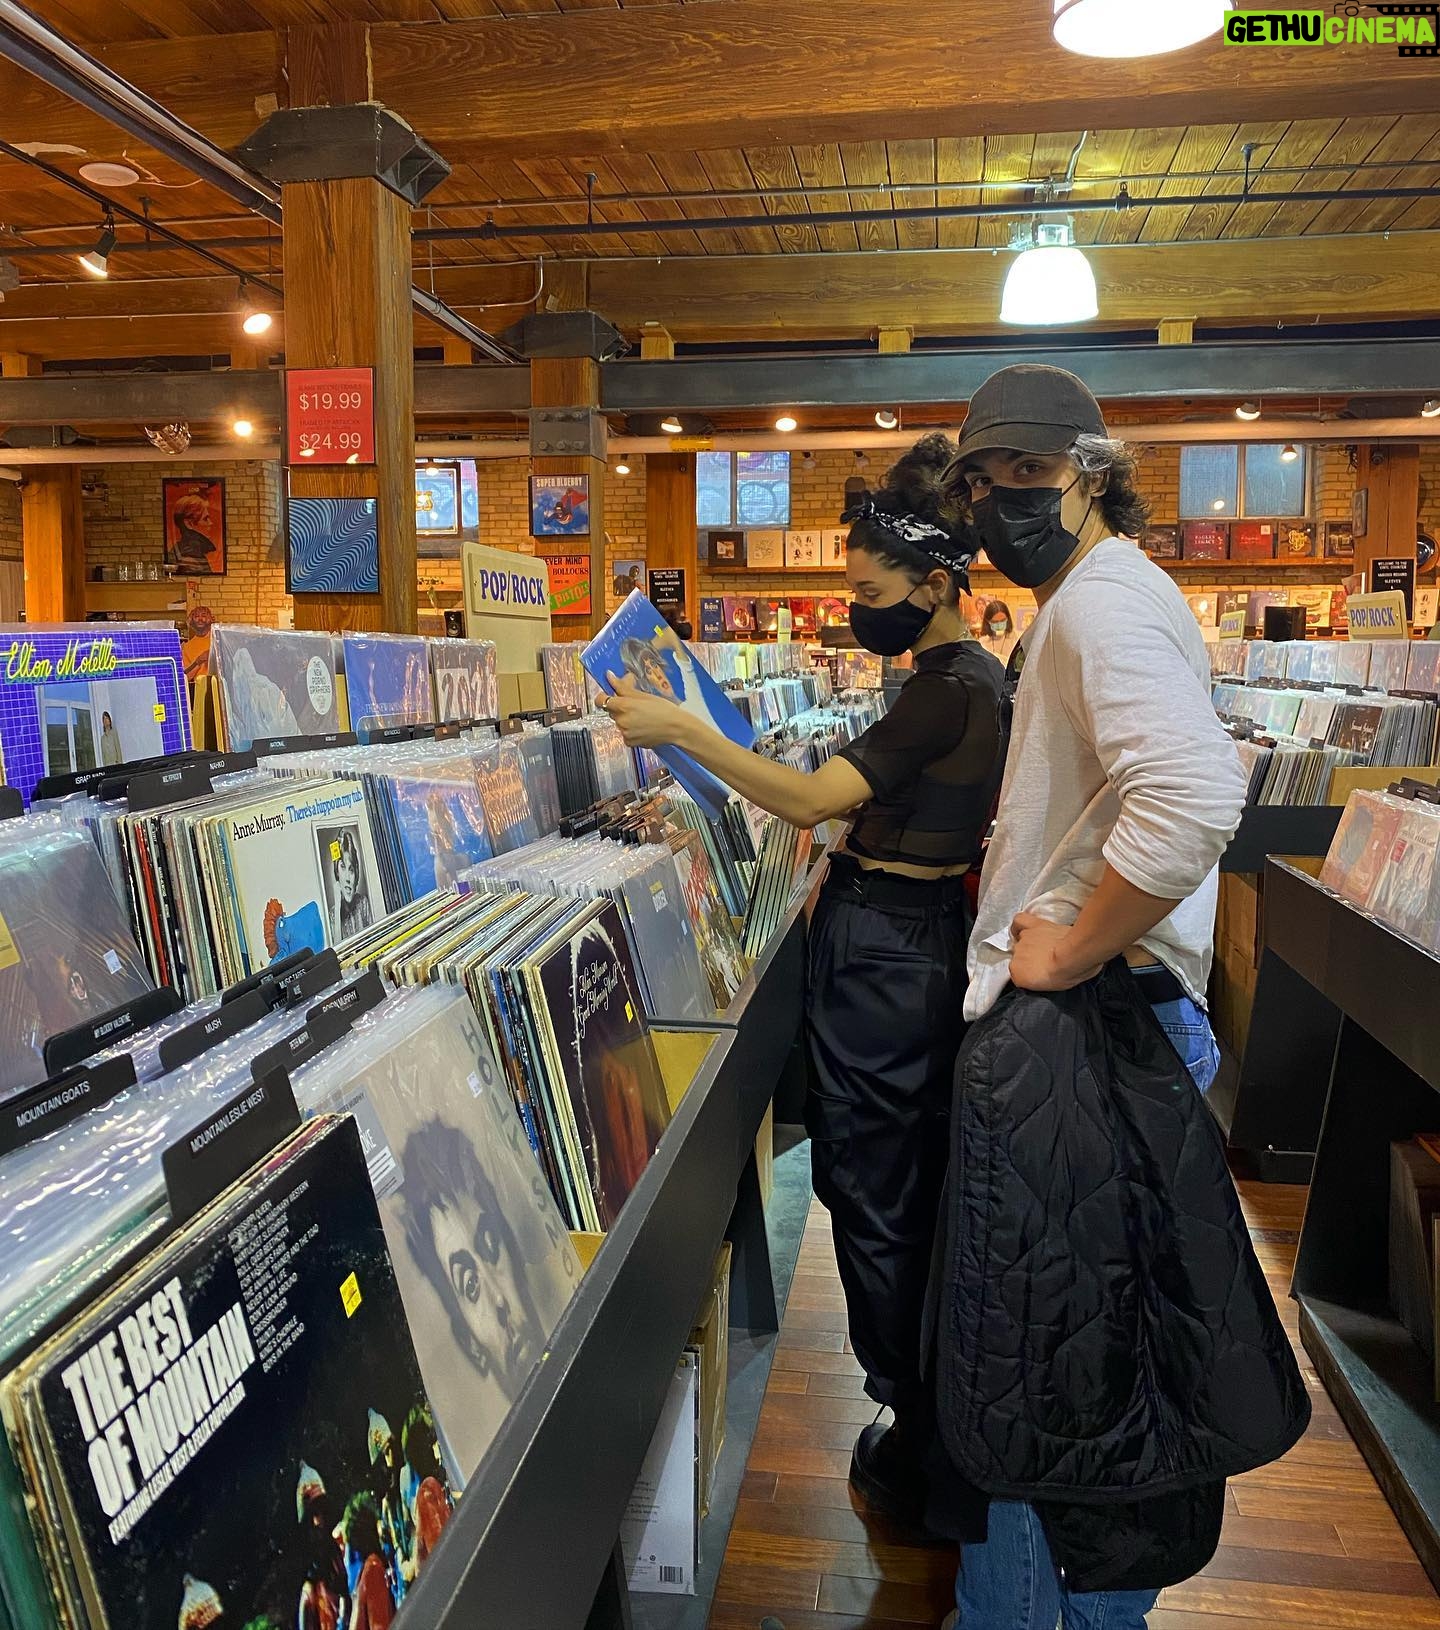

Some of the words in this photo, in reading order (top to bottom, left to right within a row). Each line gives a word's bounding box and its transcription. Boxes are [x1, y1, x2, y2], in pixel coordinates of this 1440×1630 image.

[299, 392, 361, 413] $19.99
[299, 432, 361, 450] $24.99
[542, 556, 563, 566] EVER
[565, 556, 582, 565] MIND
[552, 568, 589, 576] BOLLOCKS
[480, 569, 546, 606] POP/ROCK
[1350, 606, 1396, 630] POP/ROCK
[7, 641, 53, 680] Elton
[56, 638, 117, 676] Motello
[233, 821, 256, 841] Anne
[204, 1017, 222, 1034] MUSH
[16, 1094, 63, 1128] MOUNTAIN
[61, 1080, 91, 1104] GOATS
[246, 1087, 265, 1109] WEST
[255, 1200, 273, 1220] QUEEN
[236, 1261, 251, 1279] ROLL
[249, 1248, 264, 1267] OVER
[262, 1225, 290, 1255] BEETHOVEN
[240, 1274, 252, 1291] FOR
[272, 1241, 287, 1260] FARM
[242, 1286, 255, 1301] THE
[253, 1269, 273, 1292] ANIMAL
[271, 1250, 291, 1275] TRAINER
[289, 1242, 300, 1257] AND
[298, 1233, 309, 1247] THE
[307, 1223, 319, 1240] TOAD
[245, 1291, 263, 1314] NEVER
[262, 1285, 270, 1298] IN
[275, 1267, 287, 1285] LIFE
[248, 1303, 265, 1326] DON'T
[264, 1291, 279, 1310] LOOK
[278, 1272, 298, 1297] AROUND
[252, 1296, 288, 1337] CROSSROADER
[275, 1314, 298, 1343] CHORALE
[61, 1331, 135, 1442] THE
[118, 1276, 193, 1393] BEST
[262, 1352, 277, 1374] BOYS
[275, 1346, 283, 1359] IN
[281, 1335, 293, 1352] THE
[290, 1322, 305, 1342] BAND
[87, 1417, 137, 1518] OF
[124, 1301, 256, 1480] MOUNTAIN
[108, 1485, 154, 1546] FEATURING
[146, 1462, 176, 1501] LESLIE
[168, 1440, 192, 1476] WEST
